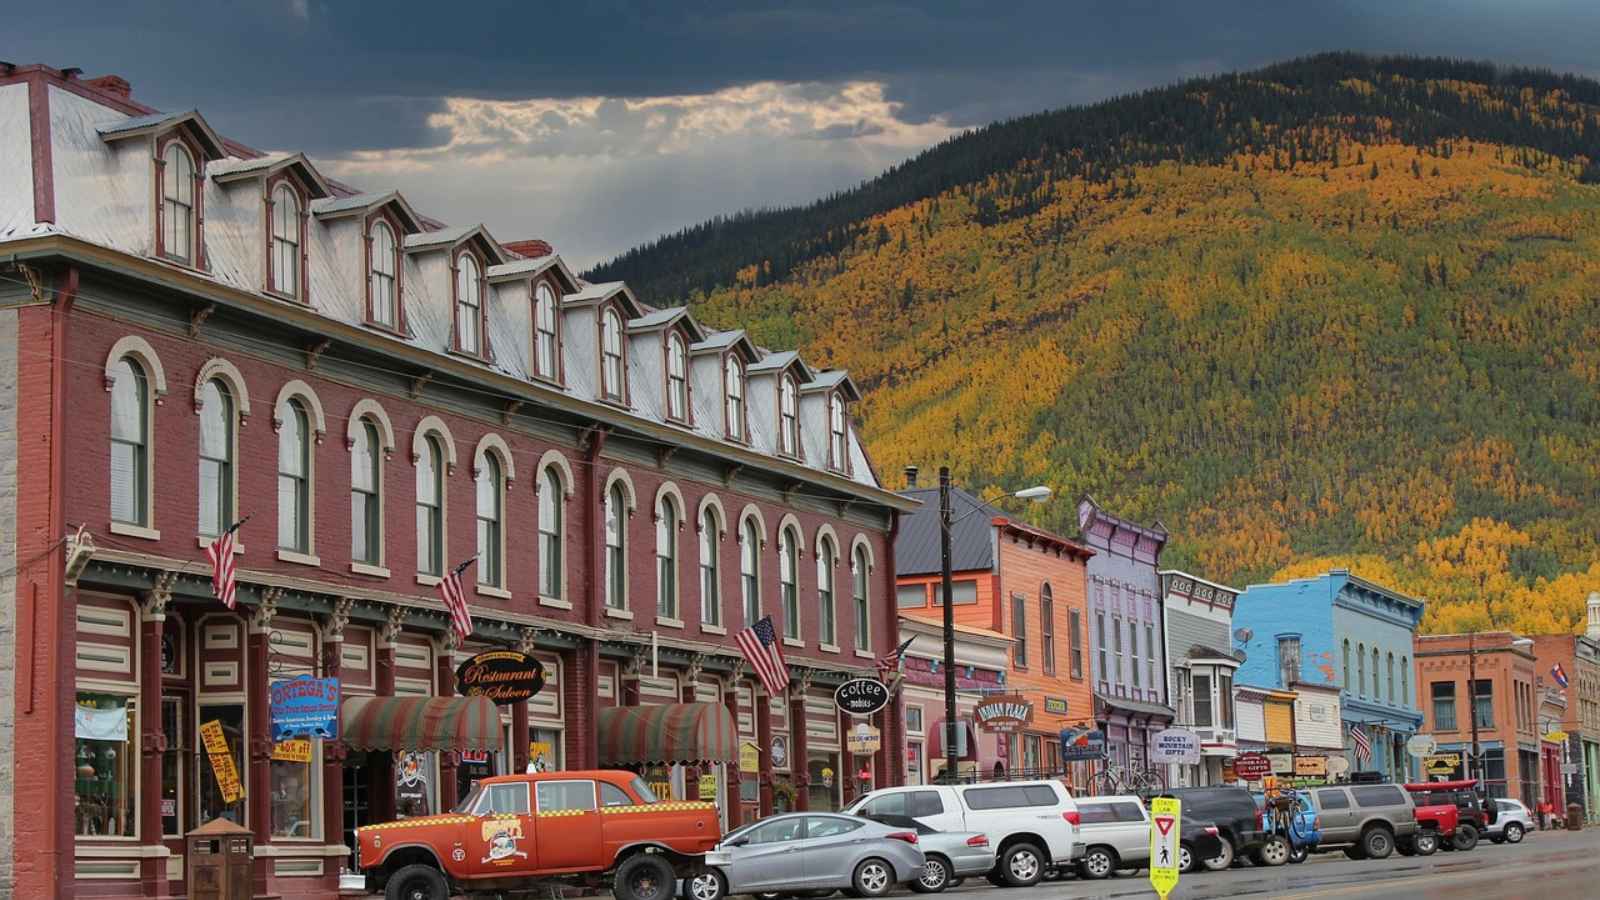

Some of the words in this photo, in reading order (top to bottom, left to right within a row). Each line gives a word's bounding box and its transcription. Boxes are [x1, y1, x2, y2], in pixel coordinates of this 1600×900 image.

[464, 665, 537, 684] Restaurant
[841, 681, 881, 698] coffee
[1005, 703, 1028, 721] PLAZA
